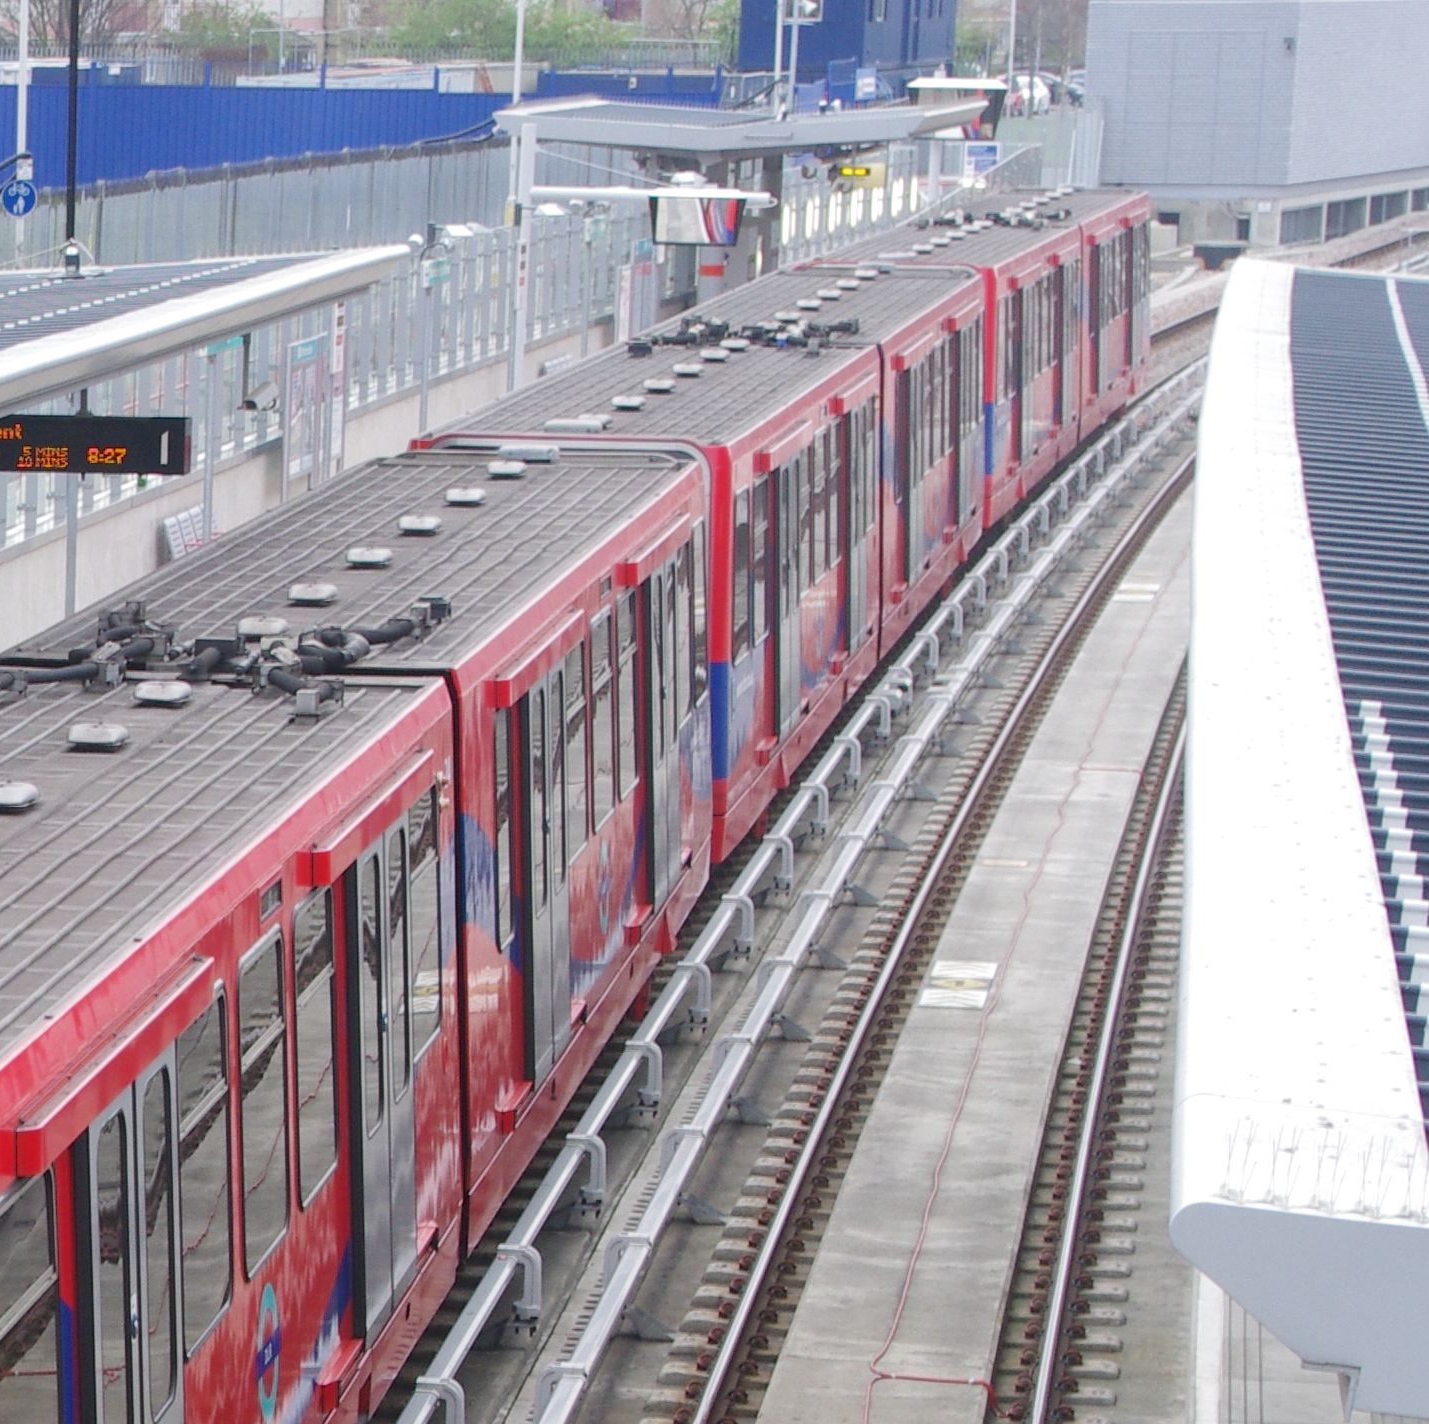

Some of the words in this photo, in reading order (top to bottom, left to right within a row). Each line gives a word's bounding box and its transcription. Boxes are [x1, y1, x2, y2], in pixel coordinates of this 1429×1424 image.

[34, 447, 69, 456] MINS
[159, 430, 169, 465] 1
[34, 457, 69, 467] MINS
[85, 447, 127, 465] 8:27
